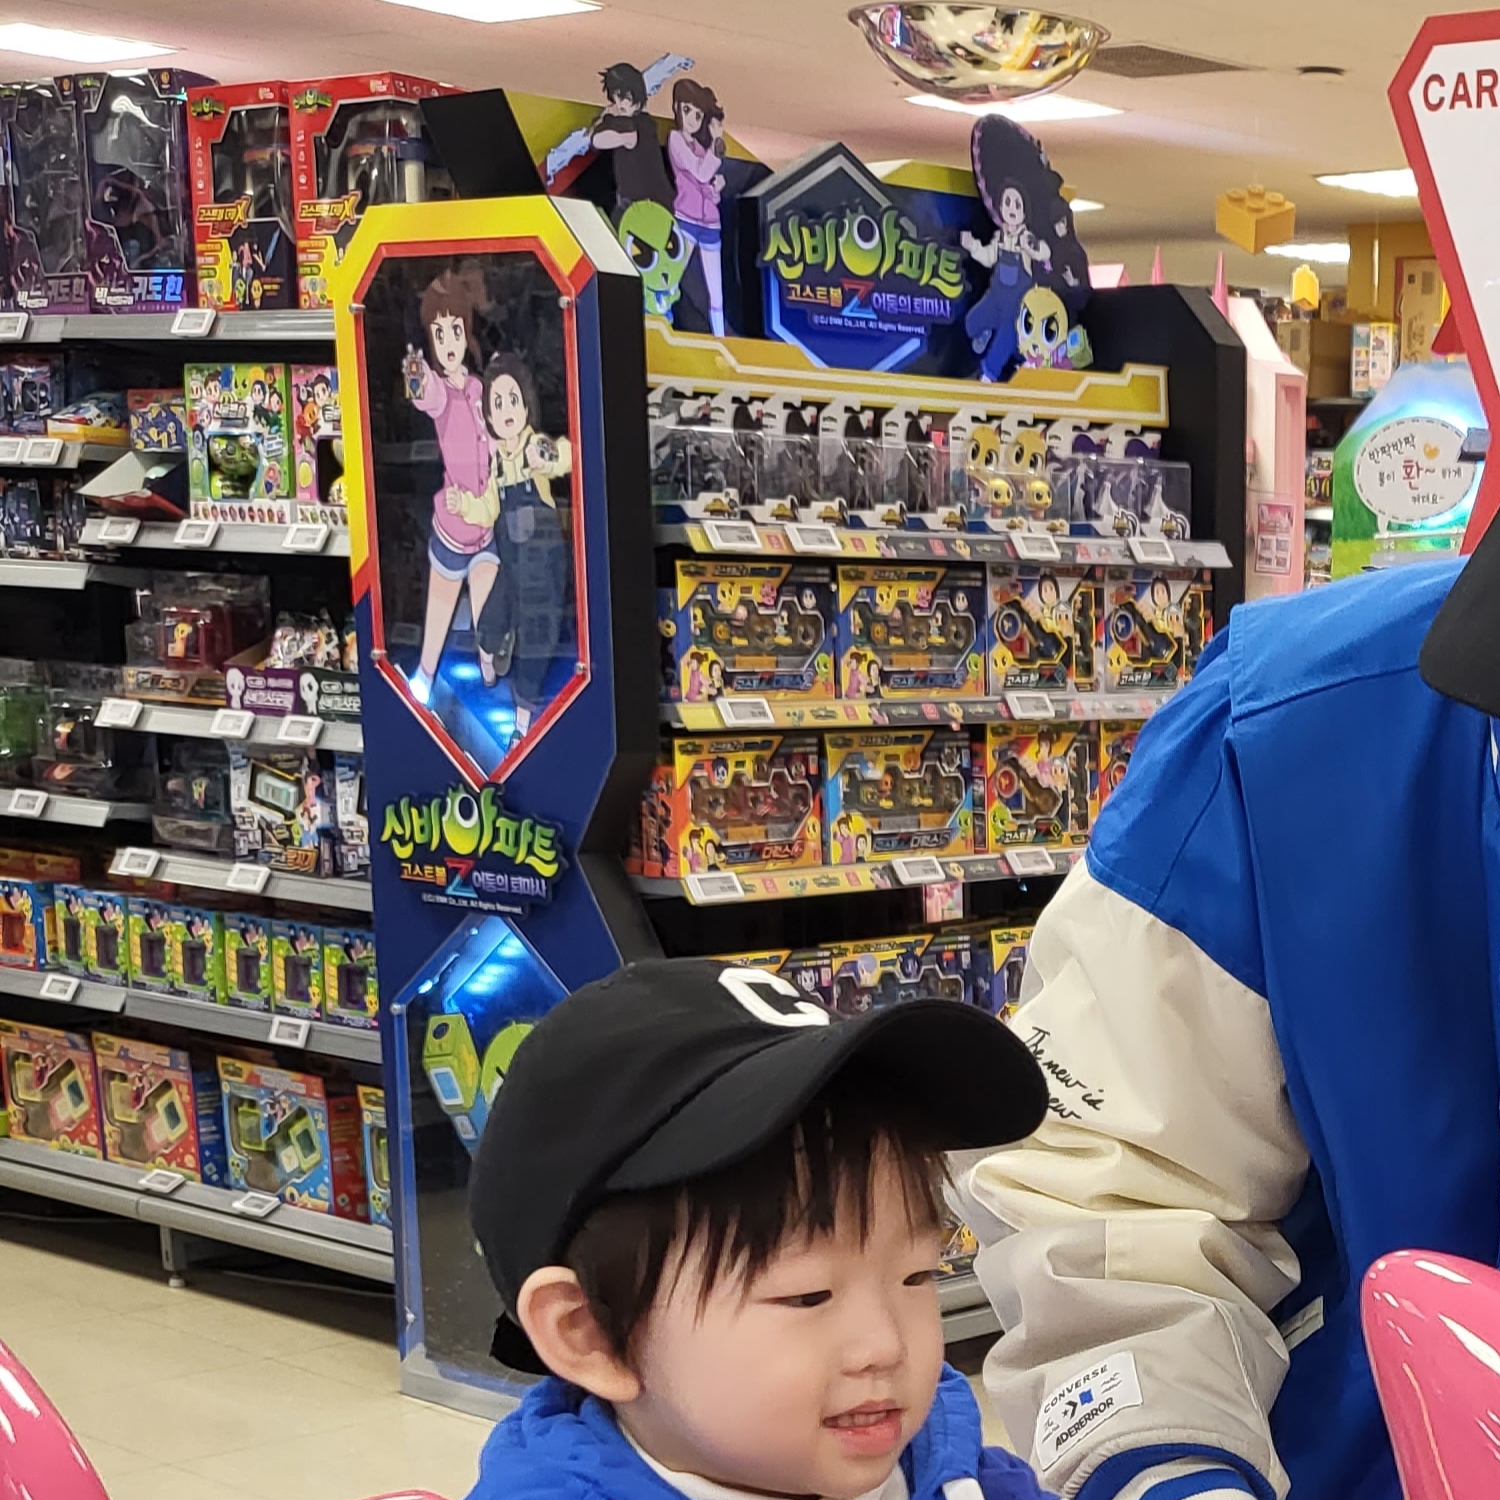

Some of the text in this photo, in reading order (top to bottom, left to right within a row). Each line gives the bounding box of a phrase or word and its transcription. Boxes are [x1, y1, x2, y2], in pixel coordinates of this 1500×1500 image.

[763, 210, 965, 299] 신비아파트
[787, 278, 951, 320] 고스트볼 Z 어둠의 퇴마사
[1368, 433, 1416, 464] 반짝반짝
[380, 785, 559, 878] 신비아파트
[401, 857, 548, 899] 고스트볼 Z 어둠의 퇴마사
[718, 966, 831, 1027] C
[1024, 1026, 1105, 1111] The new is
[1048, 1092, 1082, 1120] ew
[1044, 1364, 1109, 1414] CONVERSE
[1055, 1396, 1115, 1452] ADERERROR
